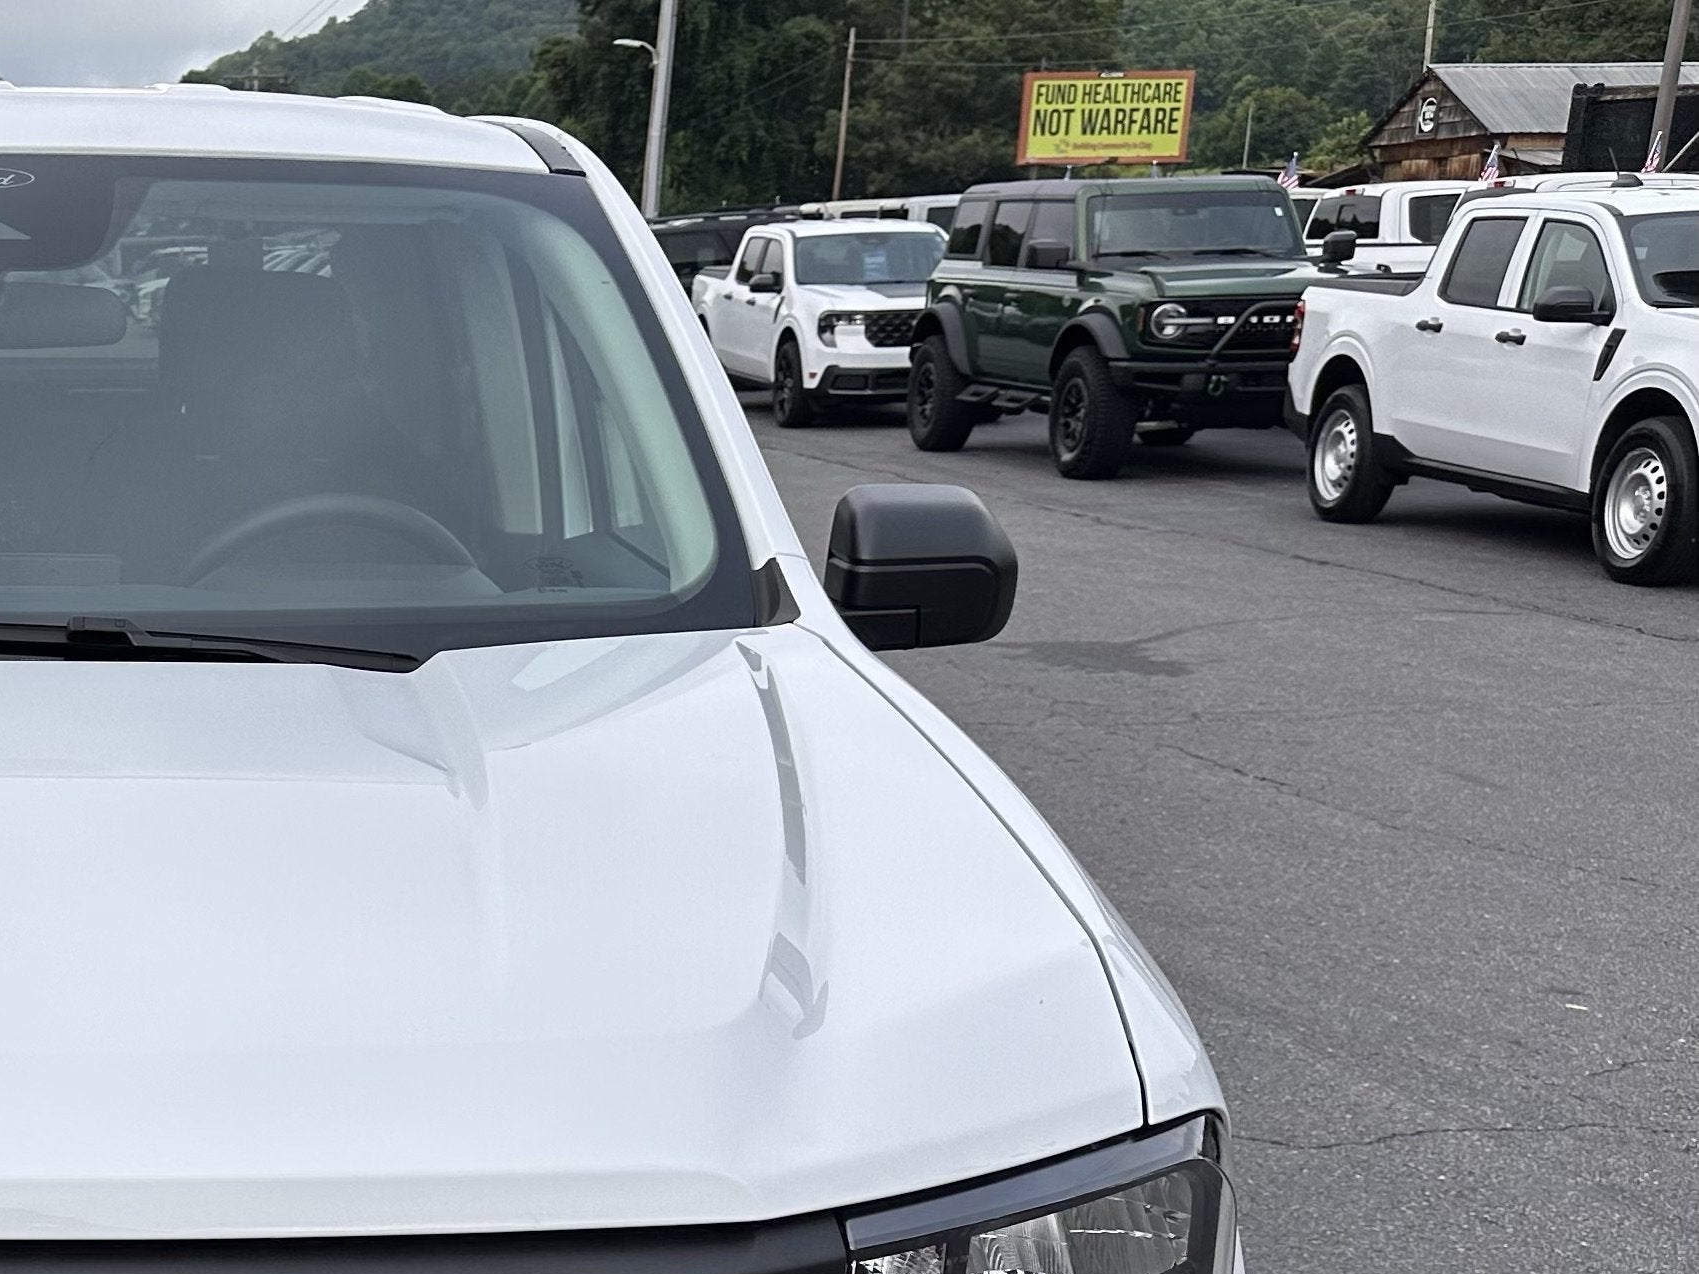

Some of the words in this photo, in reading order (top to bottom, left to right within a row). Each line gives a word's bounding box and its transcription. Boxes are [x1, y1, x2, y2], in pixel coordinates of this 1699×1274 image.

[1035, 84, 1077, 104] FUND
[1081, 82, 1183, 104] HEALTHCARE
[1033, 108, 1075, 136] NOT
[1081, 107, 1181, 135] WARFARE
